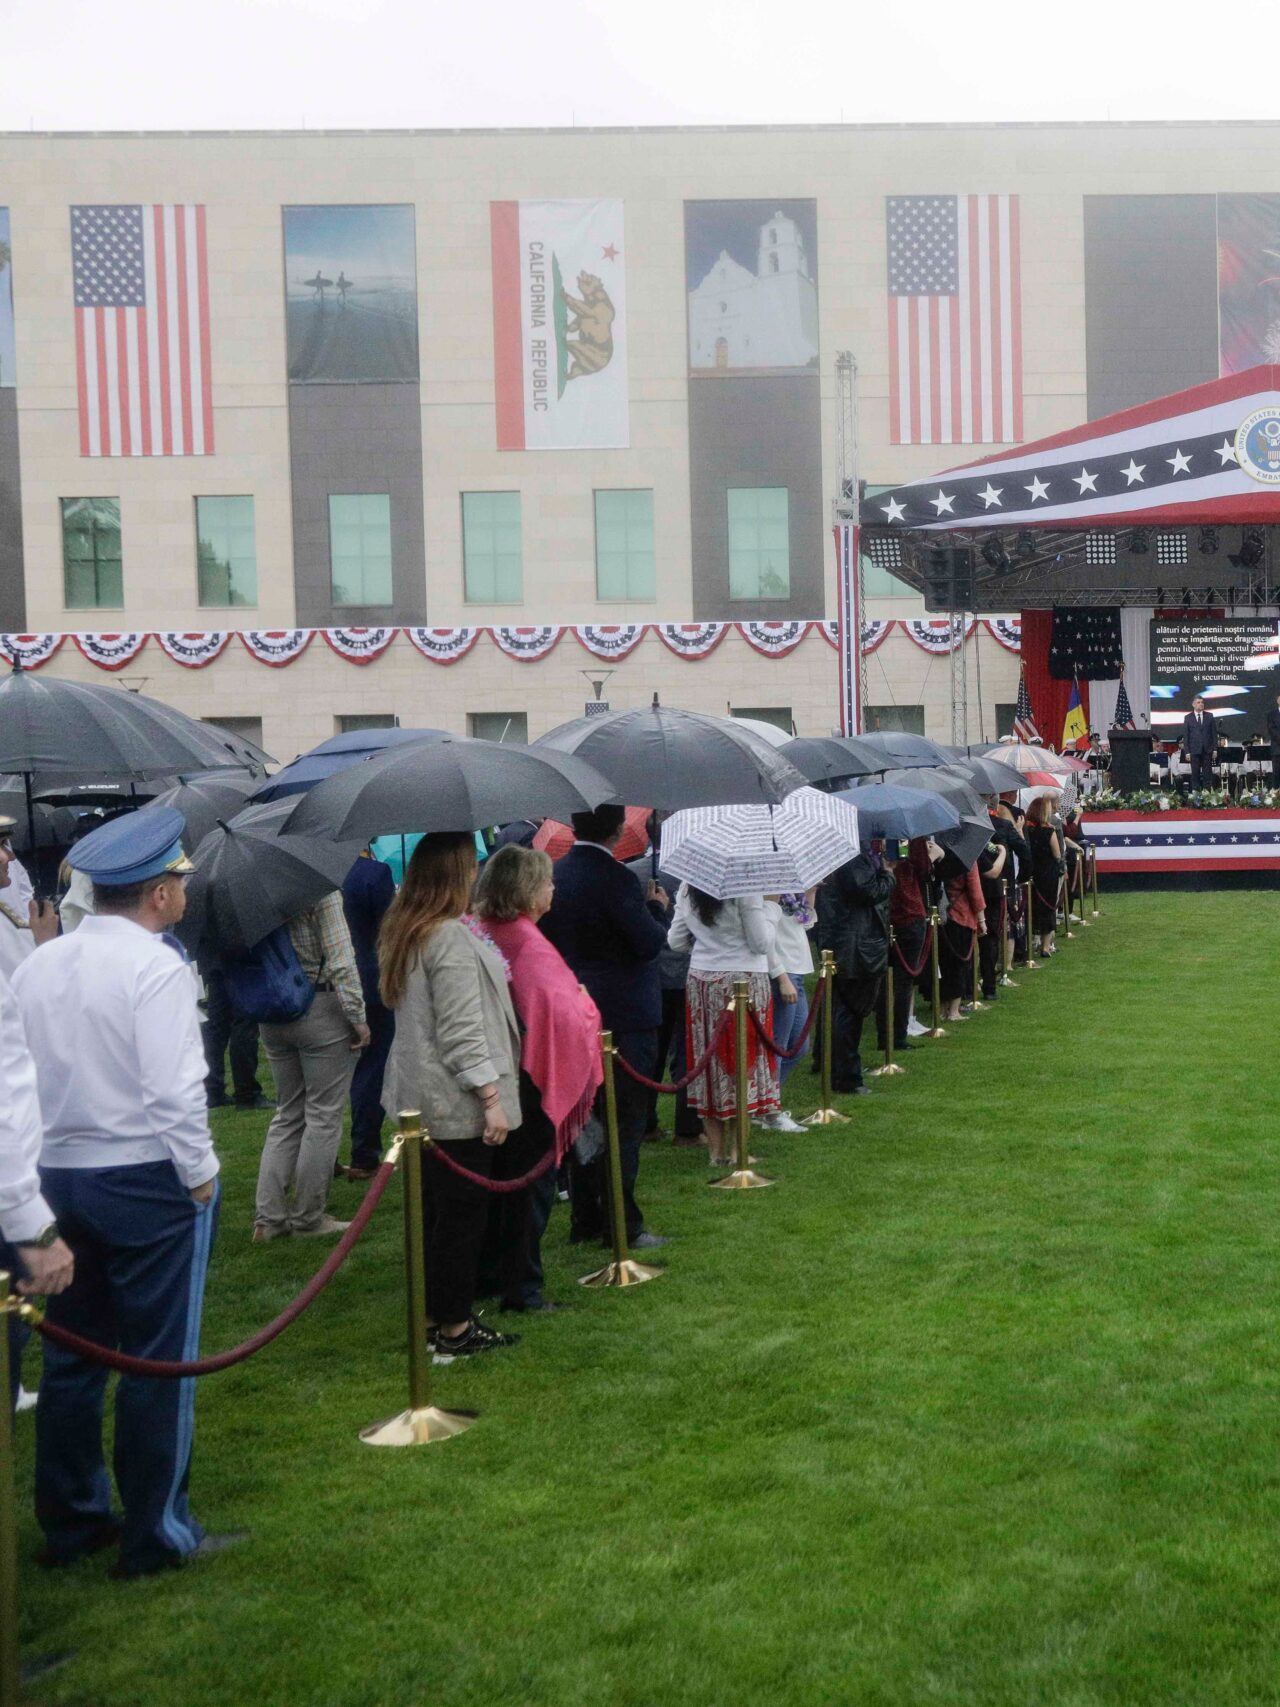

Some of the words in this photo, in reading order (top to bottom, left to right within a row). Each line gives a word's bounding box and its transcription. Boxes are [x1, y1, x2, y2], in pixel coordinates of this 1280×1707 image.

[528, 241, 546, 329] CALIFORNIA
[531, 339, 548, 412] REPUBLIC
[1239, 423, 1250, 450] UNITED
[1249, 410, 1276, 425] STATES
[1156, 625, 1180, 634] alături
[1181, 625, 1191, 634] de
[1192, 625, 1223, 635] prietenii
[1247, 624, 1275, 634] români,
[1157, 646, 1181, 654] pentru
[1182, 644, 1215, 653] libertate,
[1216, 644, 1249, 653] respectul
[1251, 645, 1275, 654] pentru
[1155, 654, 1193, 662] demnitate
[1157, 664, 1206, 674] angajamentul
[1201, 673, 1239, 681] securitate.
